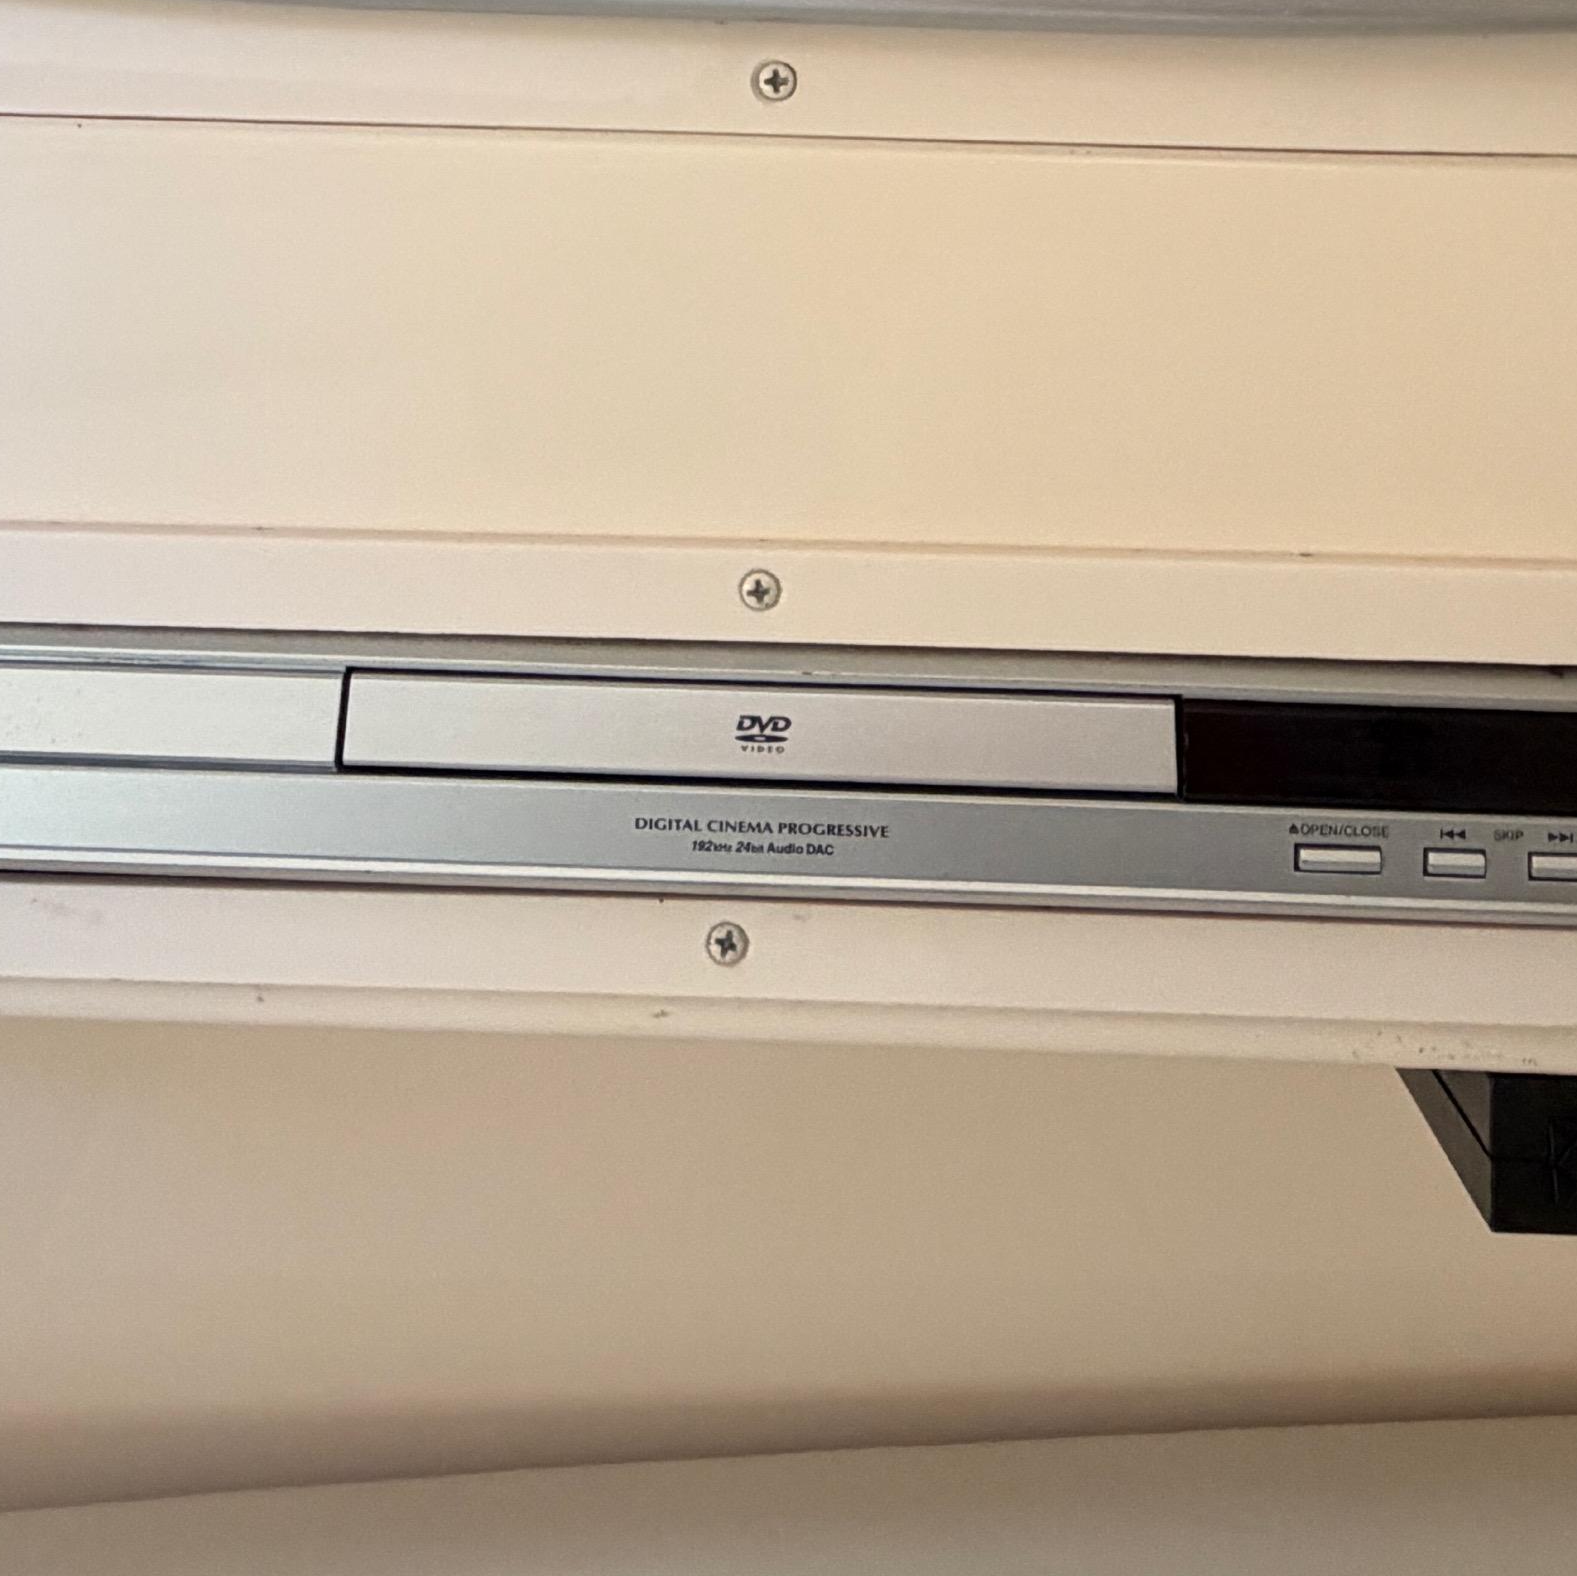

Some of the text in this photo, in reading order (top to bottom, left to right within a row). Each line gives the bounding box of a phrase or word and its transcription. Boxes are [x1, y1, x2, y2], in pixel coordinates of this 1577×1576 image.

[736, 714, 792, 734] DVD
[740, 745, 785, 754] VIDEO
[635, 817, 890, 838] DIGITAL CINEMA PROGRESSIVE
[1301, 823, 1389, 839] OPEN/CLOSE
[1493, 828, 1524, 842] SKIP
[767, 842, 804, 855] Audio
[806, 843, 835, 856] DAC
